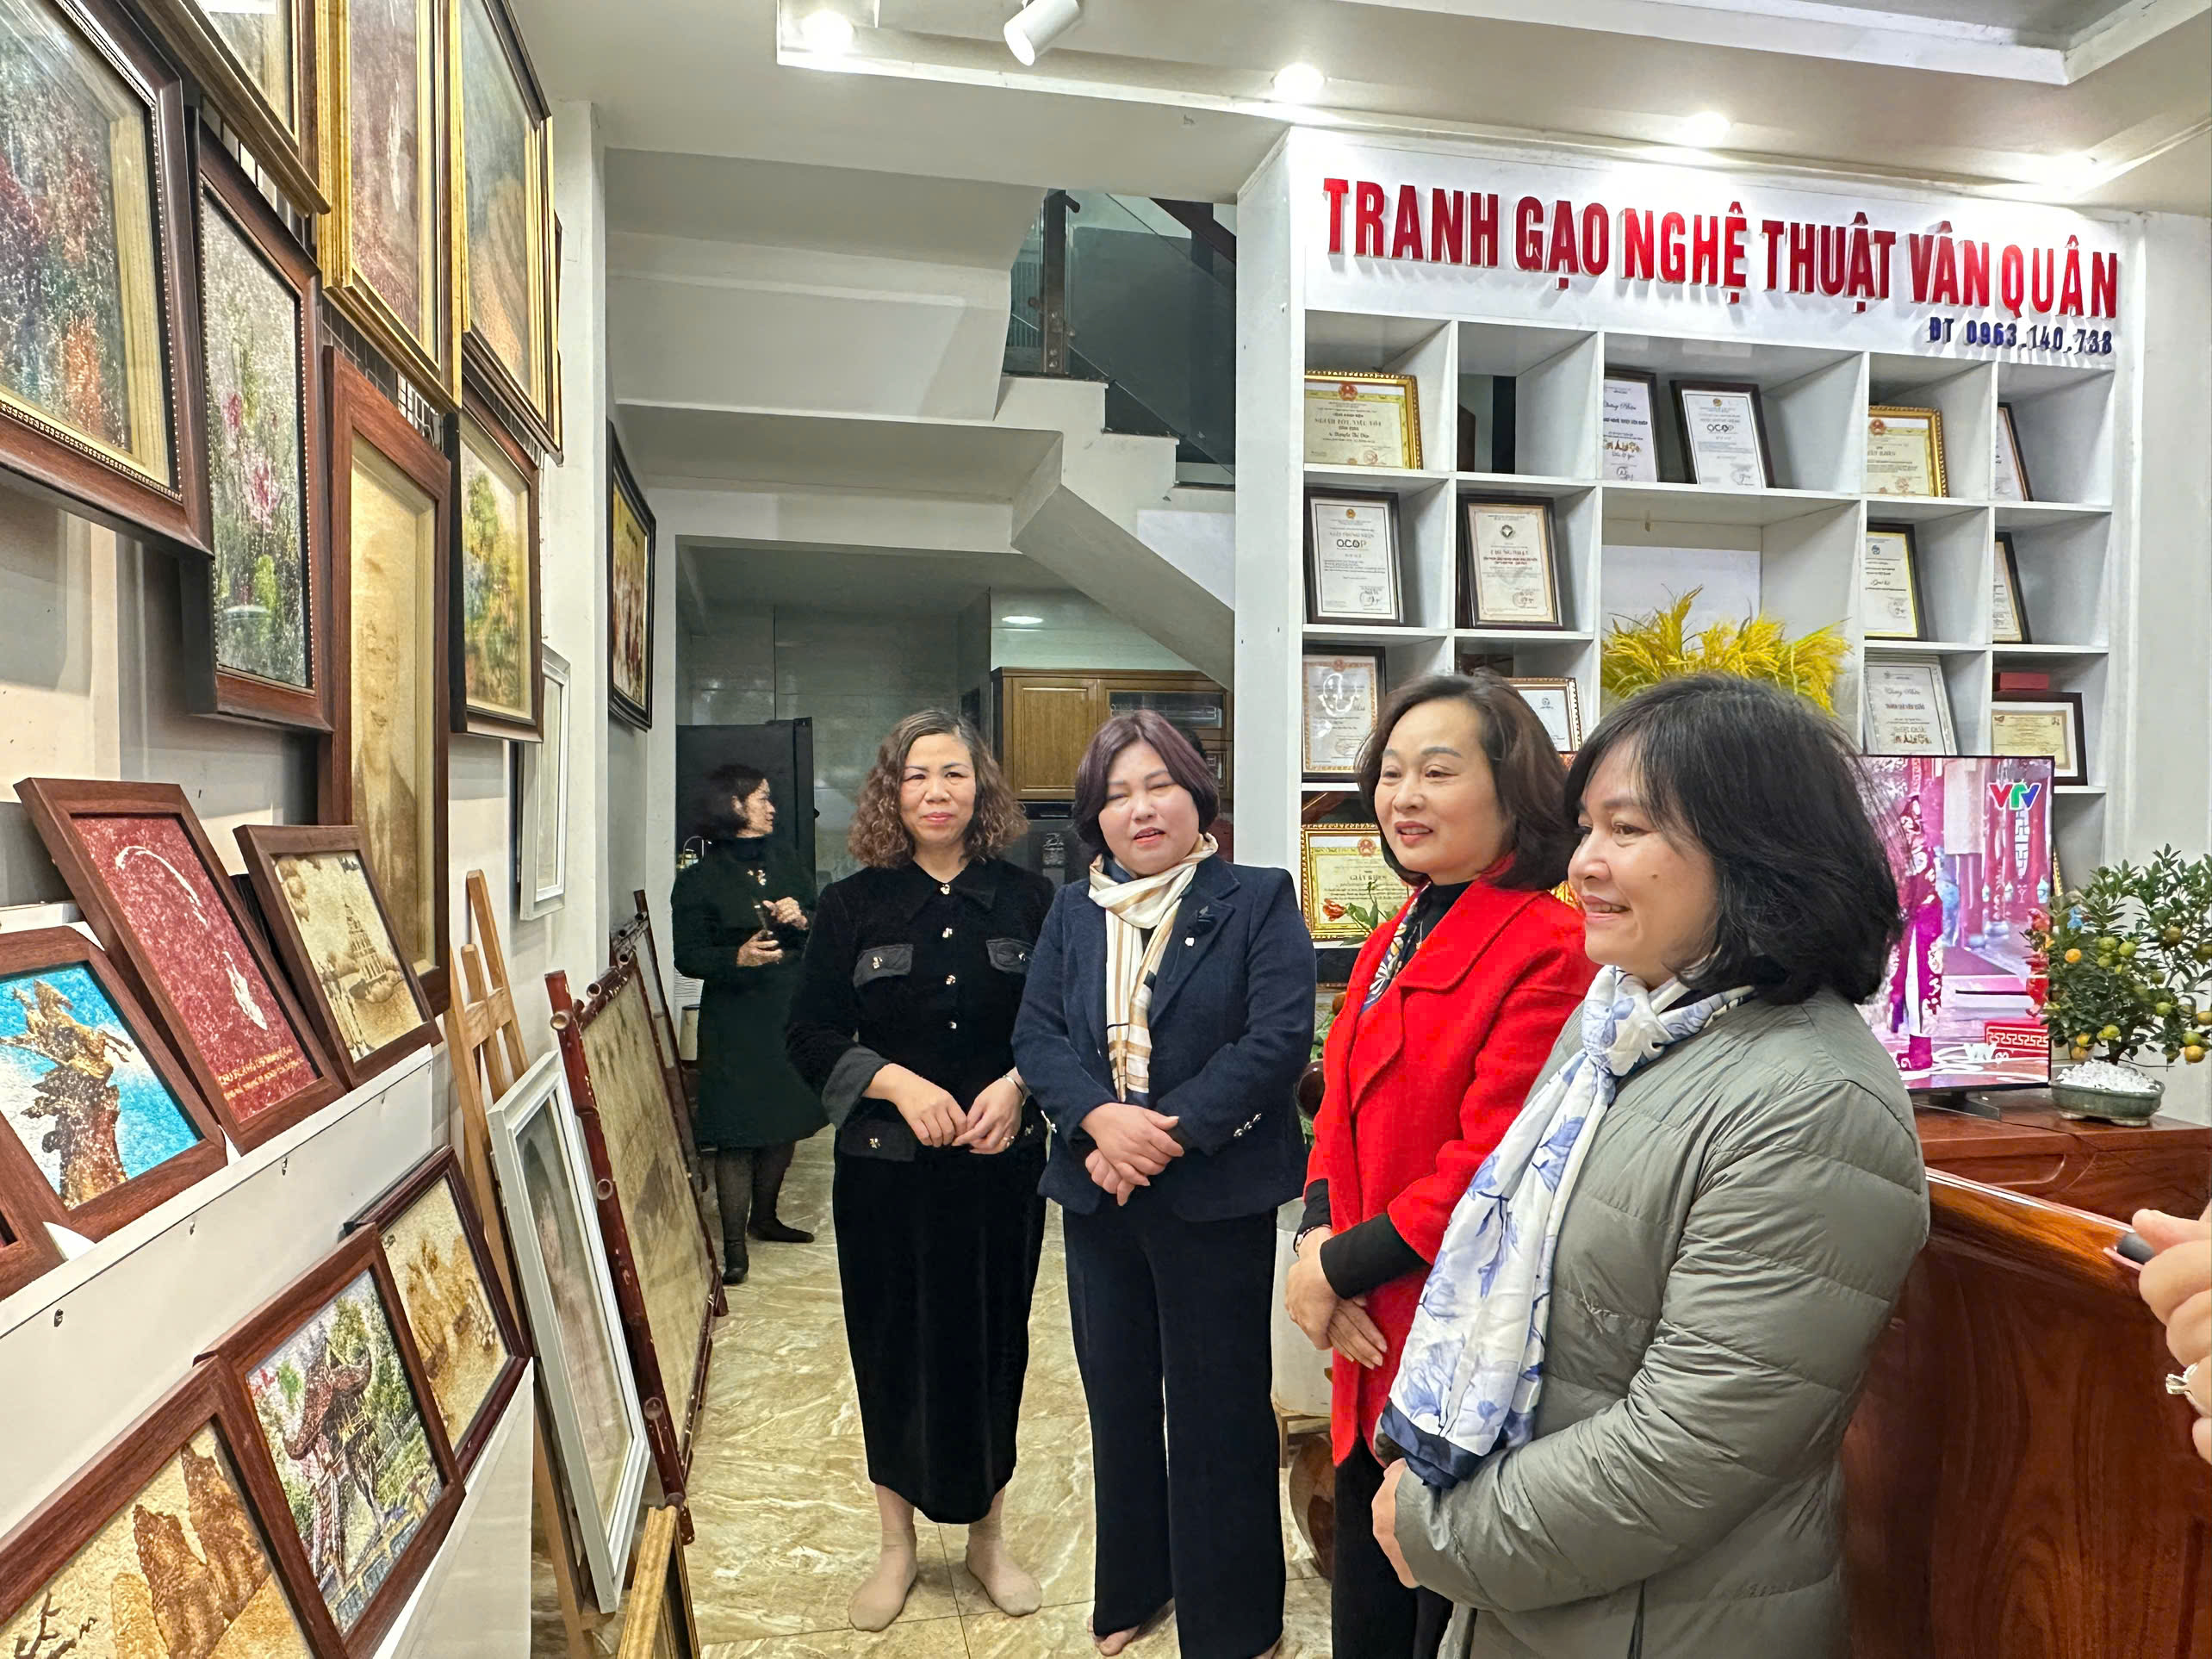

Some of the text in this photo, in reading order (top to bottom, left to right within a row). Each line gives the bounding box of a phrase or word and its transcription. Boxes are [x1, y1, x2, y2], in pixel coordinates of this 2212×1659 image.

[1322, 177, 2117, 320] TRANH GẠO NGHỆ THUẬT VÂN QUÂN
[1336, 538, 1367, 548] OCOP
[1988, 782, 2041, 810] VTV
